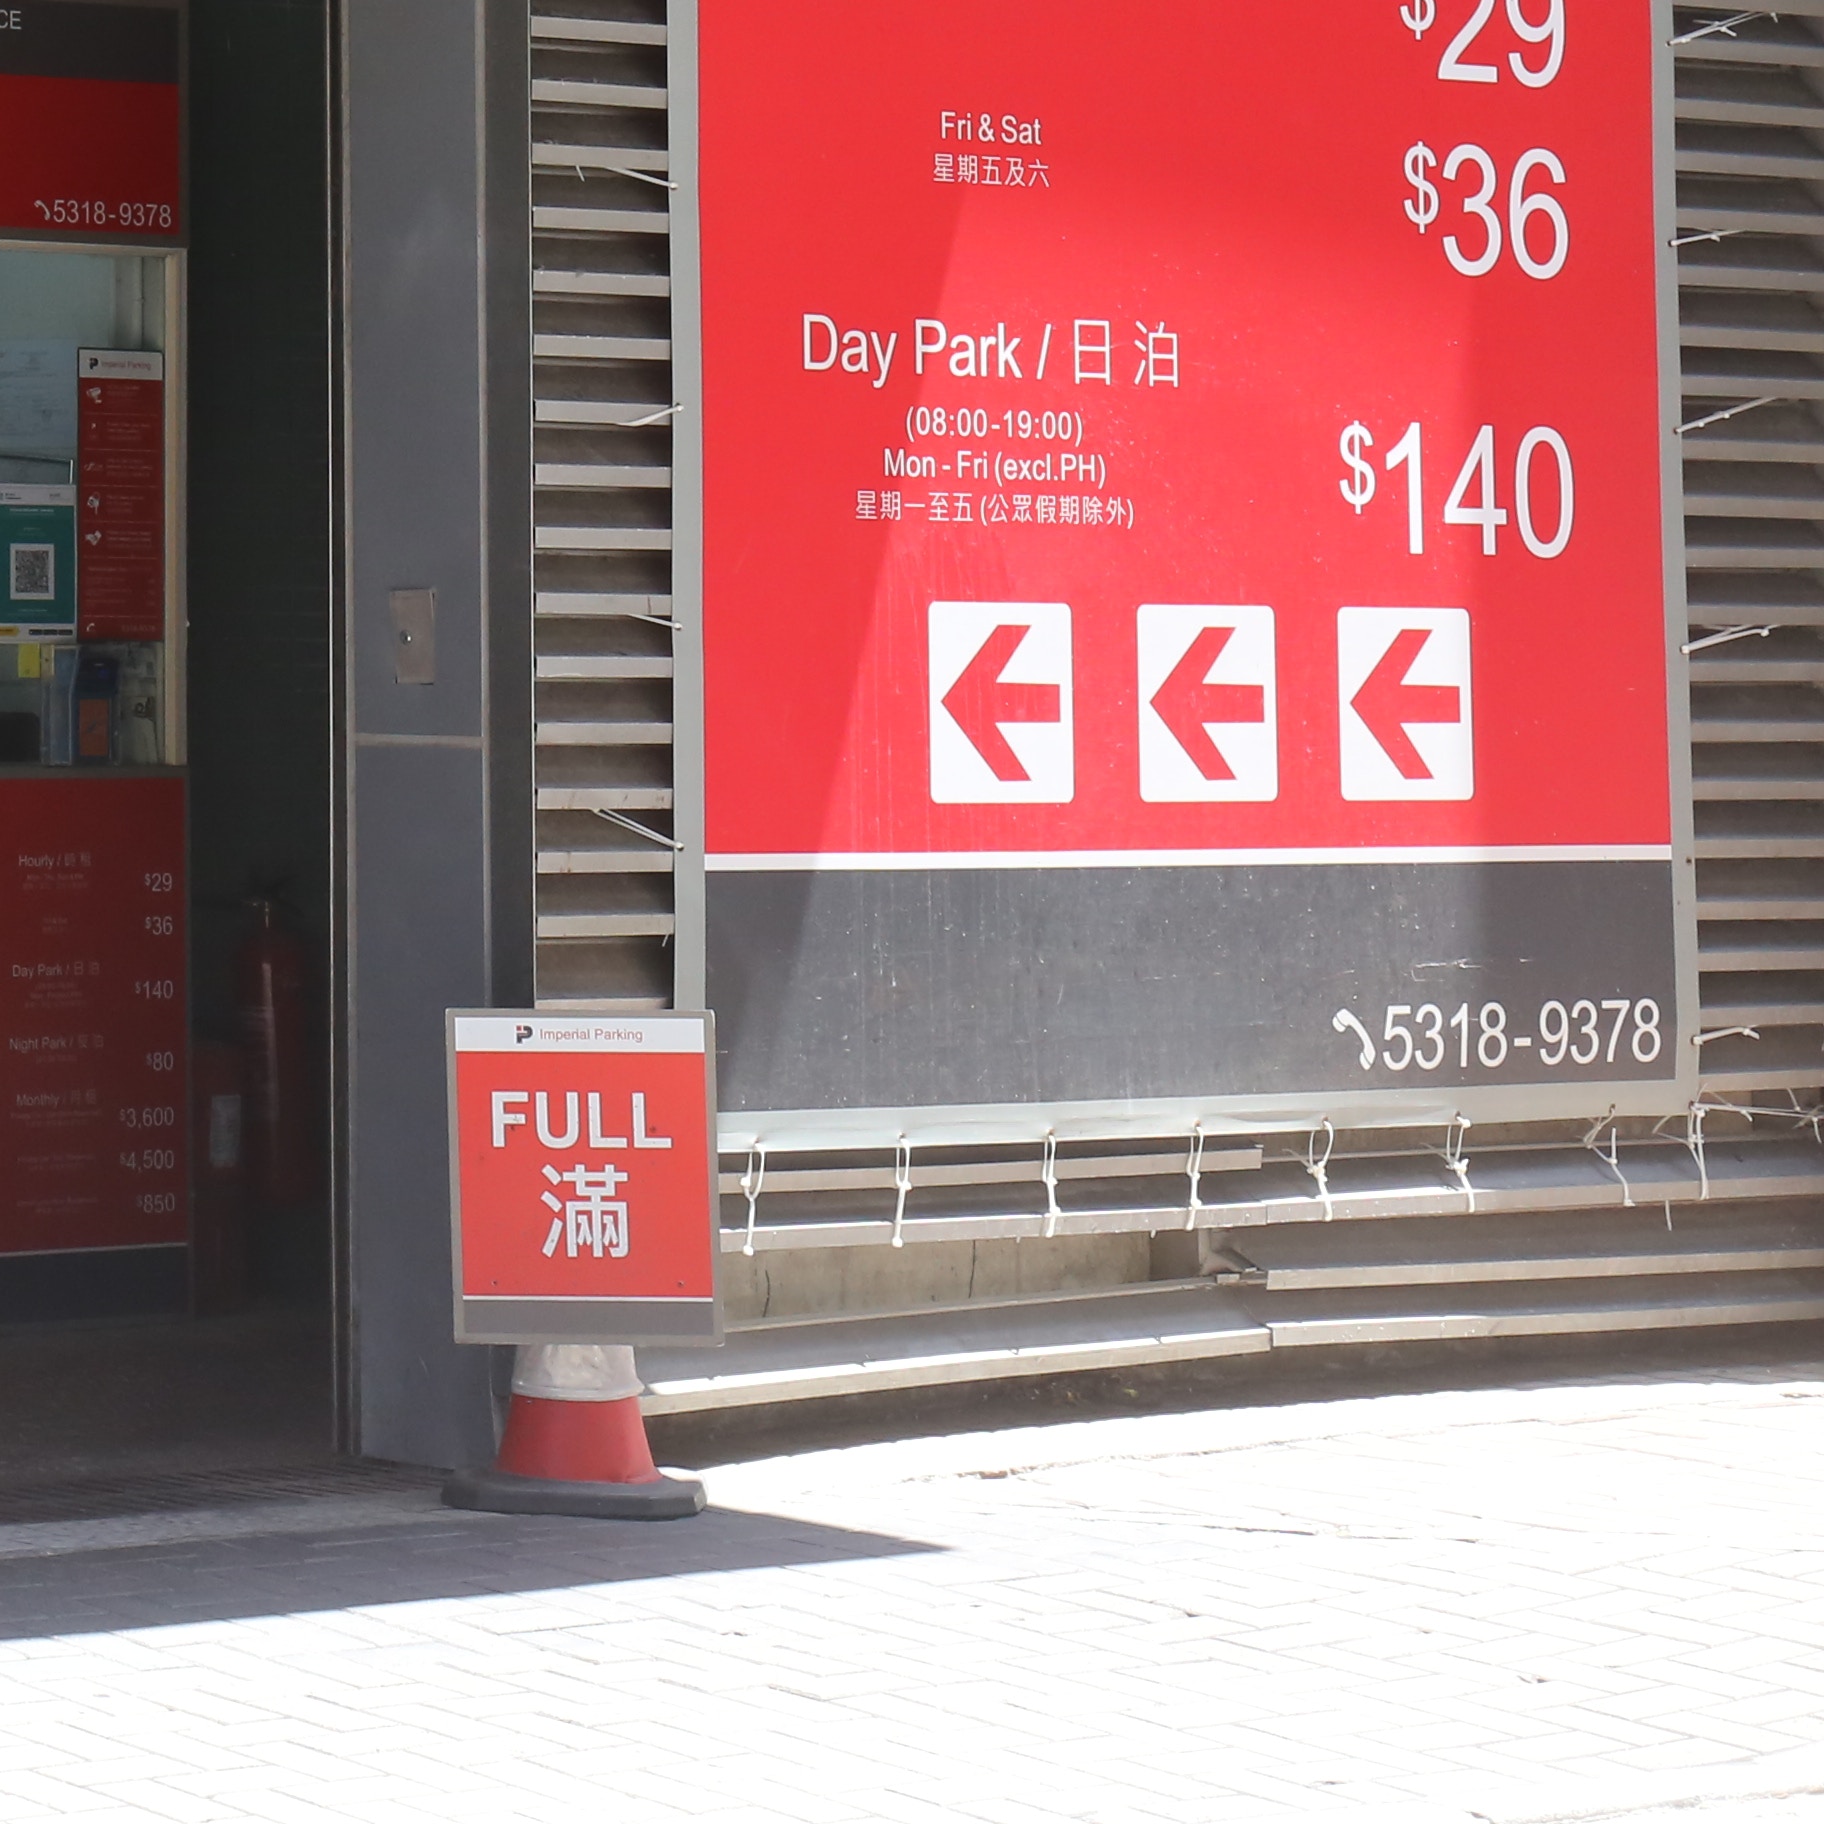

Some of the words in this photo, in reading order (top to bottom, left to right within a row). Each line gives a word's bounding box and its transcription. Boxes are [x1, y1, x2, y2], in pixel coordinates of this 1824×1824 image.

[940, 110, 972, 141] Fri
[977, 112, 996, 143] &
[1001, 113, 1042, 145] Sat
[932, 151, 1051, 188] 星期五及六
[52, 198, 173, 229] 5318-9378
[1402, 140, 1570, 281] $36
[801, 312, 899, 390] Day
[913, 317, 1024, 380] Park
[882, 447, 937, 479] Mon
[955, 449, 989, 481] Fri
[993, 450, 1107, 490] (excl.PH)
[1338, 419, 1575, 559] $140
[18, 853, 55, 870] Hourly
[144, 872, 174, 893] $29
[144, 914, 174, 936] $36
[11, 964, 35, 979] Day
[37, 962, 64, 977] Park
[134, 979, 175, 1000] $140
[8, 1037, 40, 1054] Night
[41, 1035, 68, 1051] Park
[539, 1028, 590, 1042] Imperial
[594, 1028, 643, 1043] Parking
[1381, 997, 1663, 1072] 5318-9378
[144, 1050, 175, 1072] $80
[16, 1093, 60, 1108] Monthly
[119, 1106, 175, 1130] $3,600
[491, 1090, 673, 1150] FULL
[119, 1149, 175, 1174] $4,500
[135, 1191, 176, 1214] $850
[540, 1163, 630, 1258] 滿
